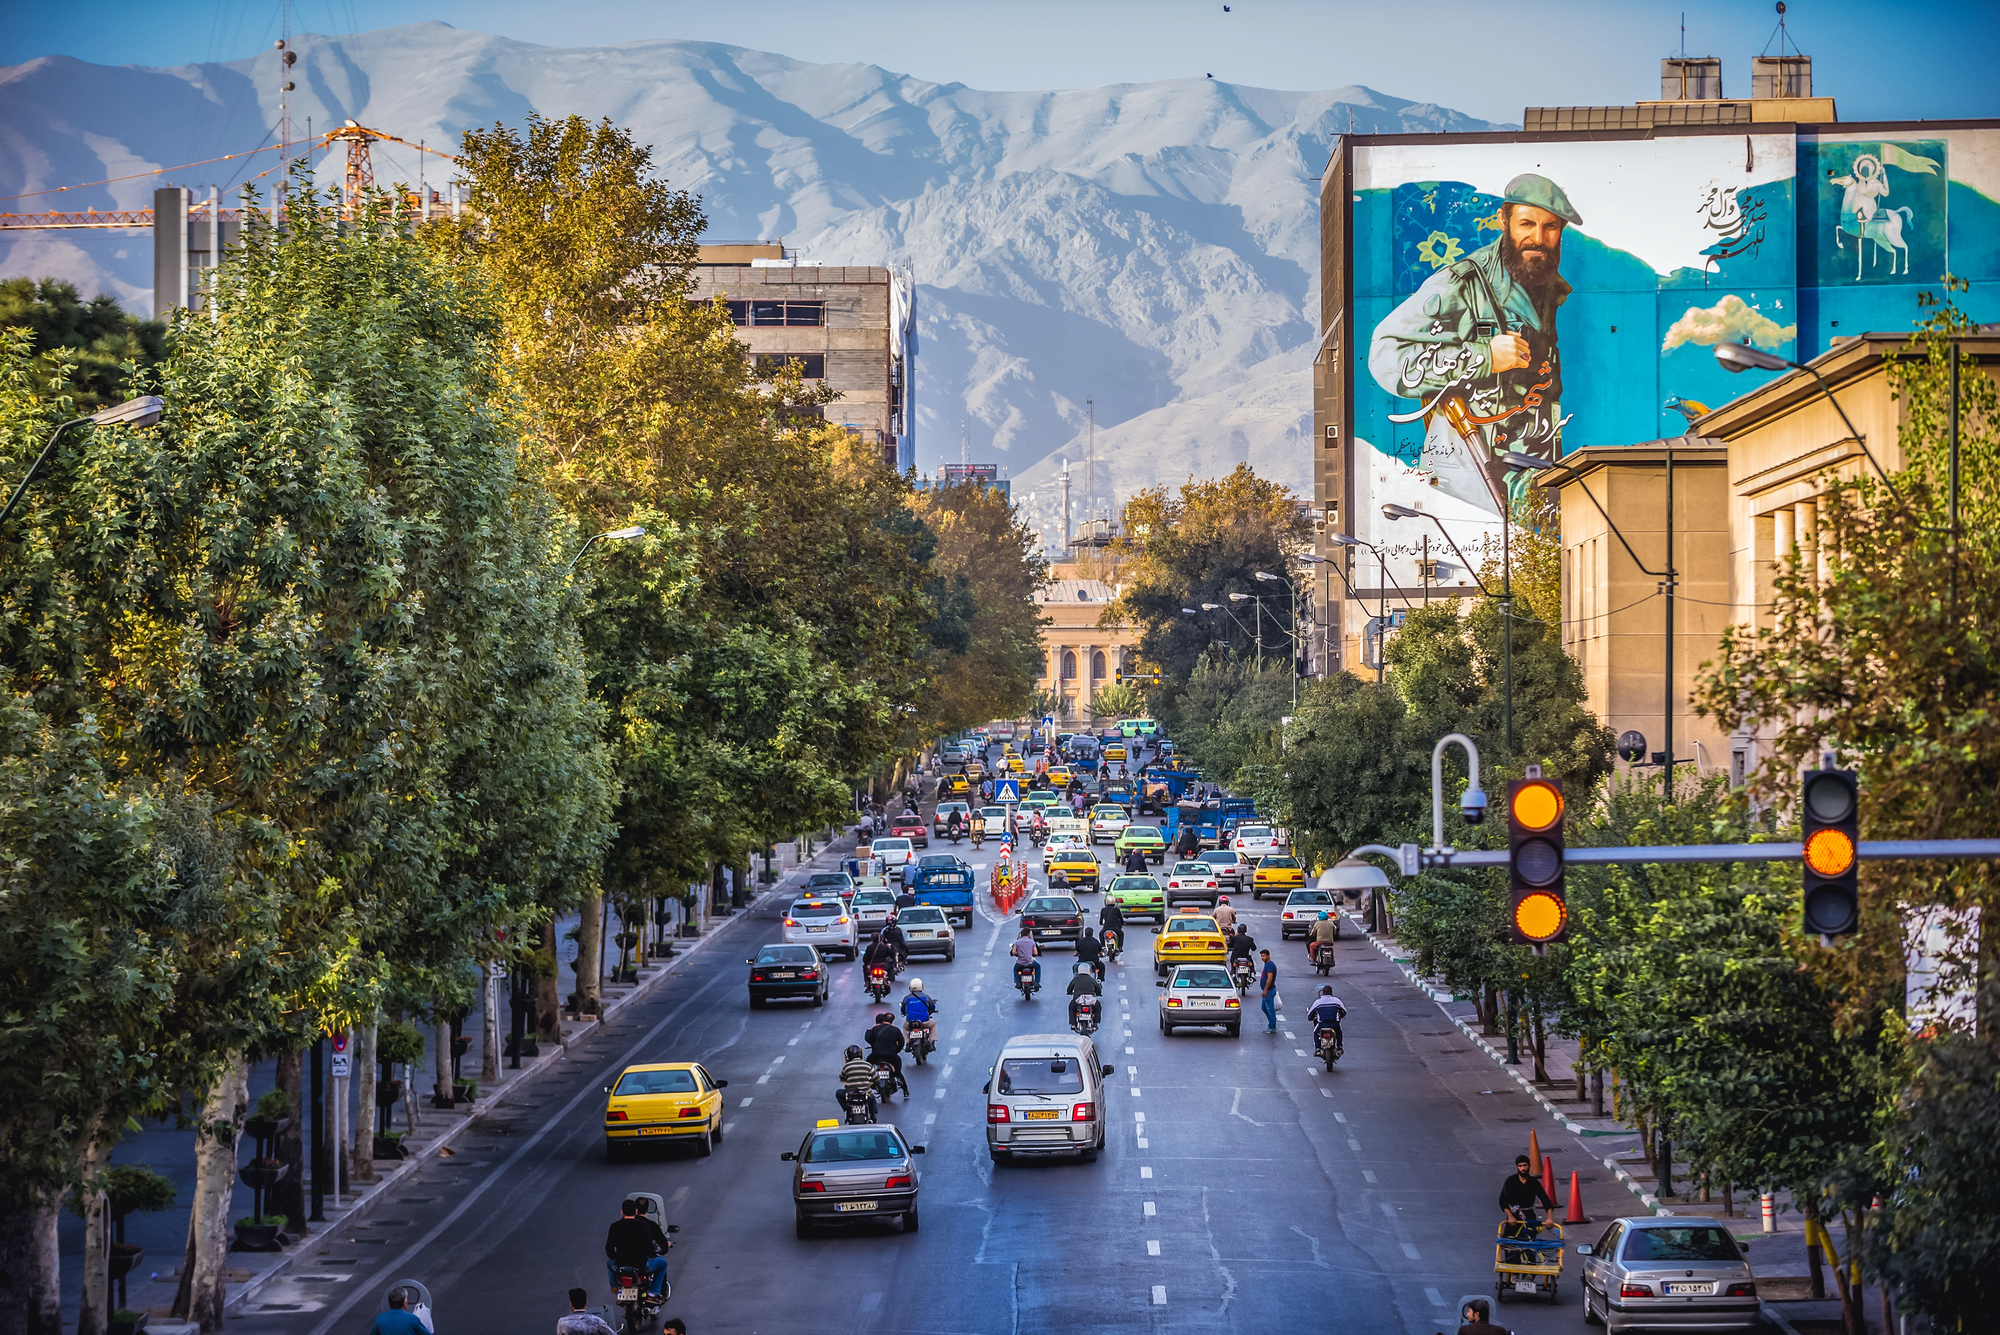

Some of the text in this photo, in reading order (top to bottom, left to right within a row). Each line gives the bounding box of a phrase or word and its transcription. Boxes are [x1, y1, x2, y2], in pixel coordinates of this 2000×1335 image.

[1387, 320, 1574, 443] سردار شهید سید مجتبی هاشمی
